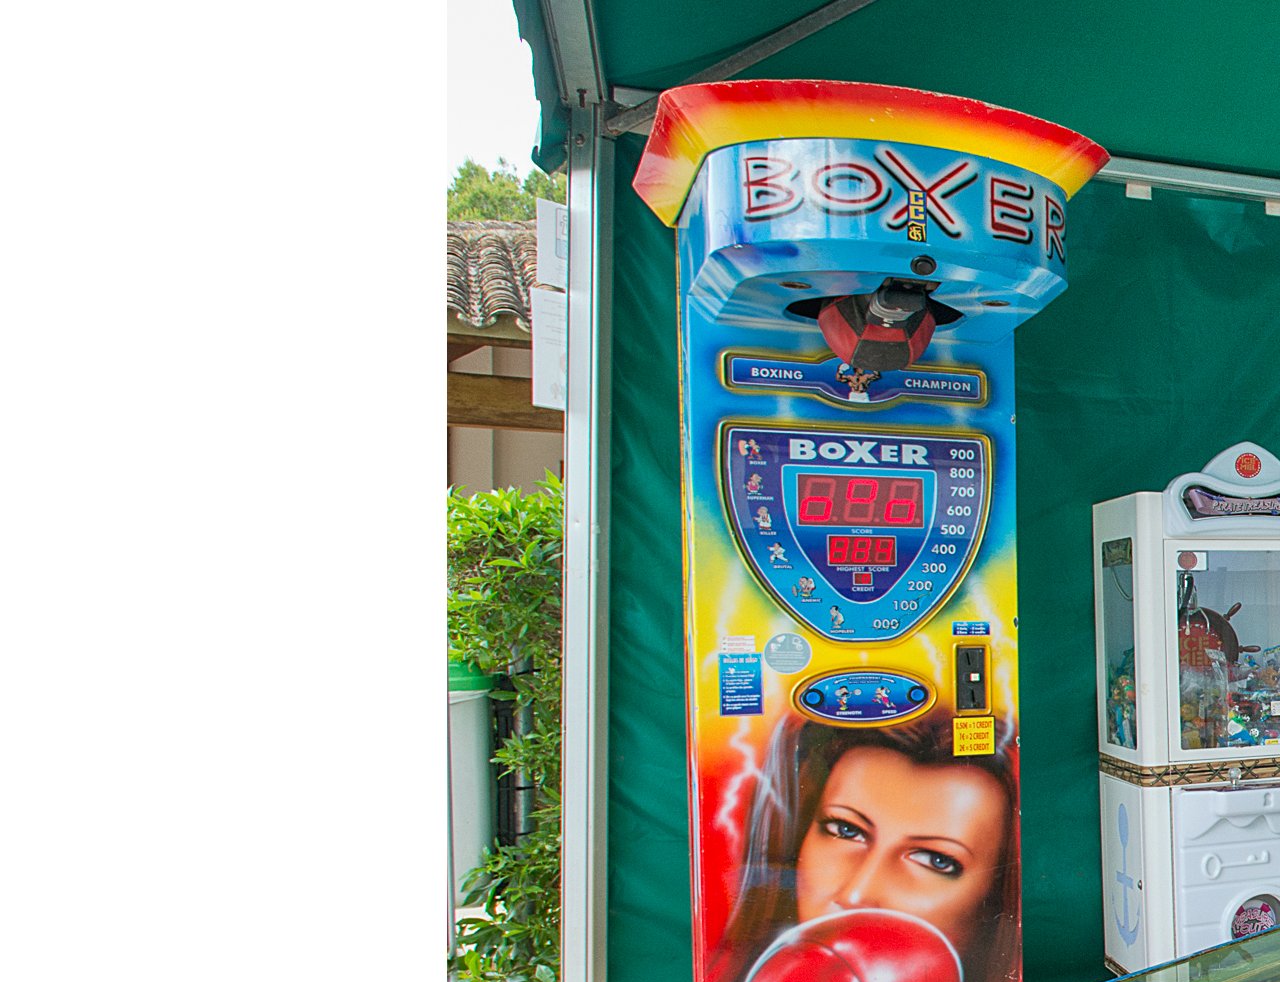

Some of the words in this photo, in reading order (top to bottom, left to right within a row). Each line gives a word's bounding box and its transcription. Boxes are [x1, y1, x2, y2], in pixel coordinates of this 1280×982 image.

[744, 148, 1067, 264] BOXER
[750, 367, 803, 380] BOXING
[904, 378, 971, 392] CHAMPION
[789, 438, 929, 465] BOXER
[950, 449, 975, 460] 900
[950, 468, 975, 479] 800
[950, 487, 975, 498] 700
[946, 505, 971, 517] 600
[1212, 501, 1244, 512] PIRATE
[940, 524, 965, 536] 500
[931, 544, 956, 556] 400
[921, 563, 946, 574] 300
[907, 580, 932, 591] 200
[893, 600, 918, 611] 100
[872, 619, 899, 630] 000
[976, 720, 993, 729] CREDIT
[973, 731, 990, 740] CREDIT
[973, 742, 990, 751] CREDIT
